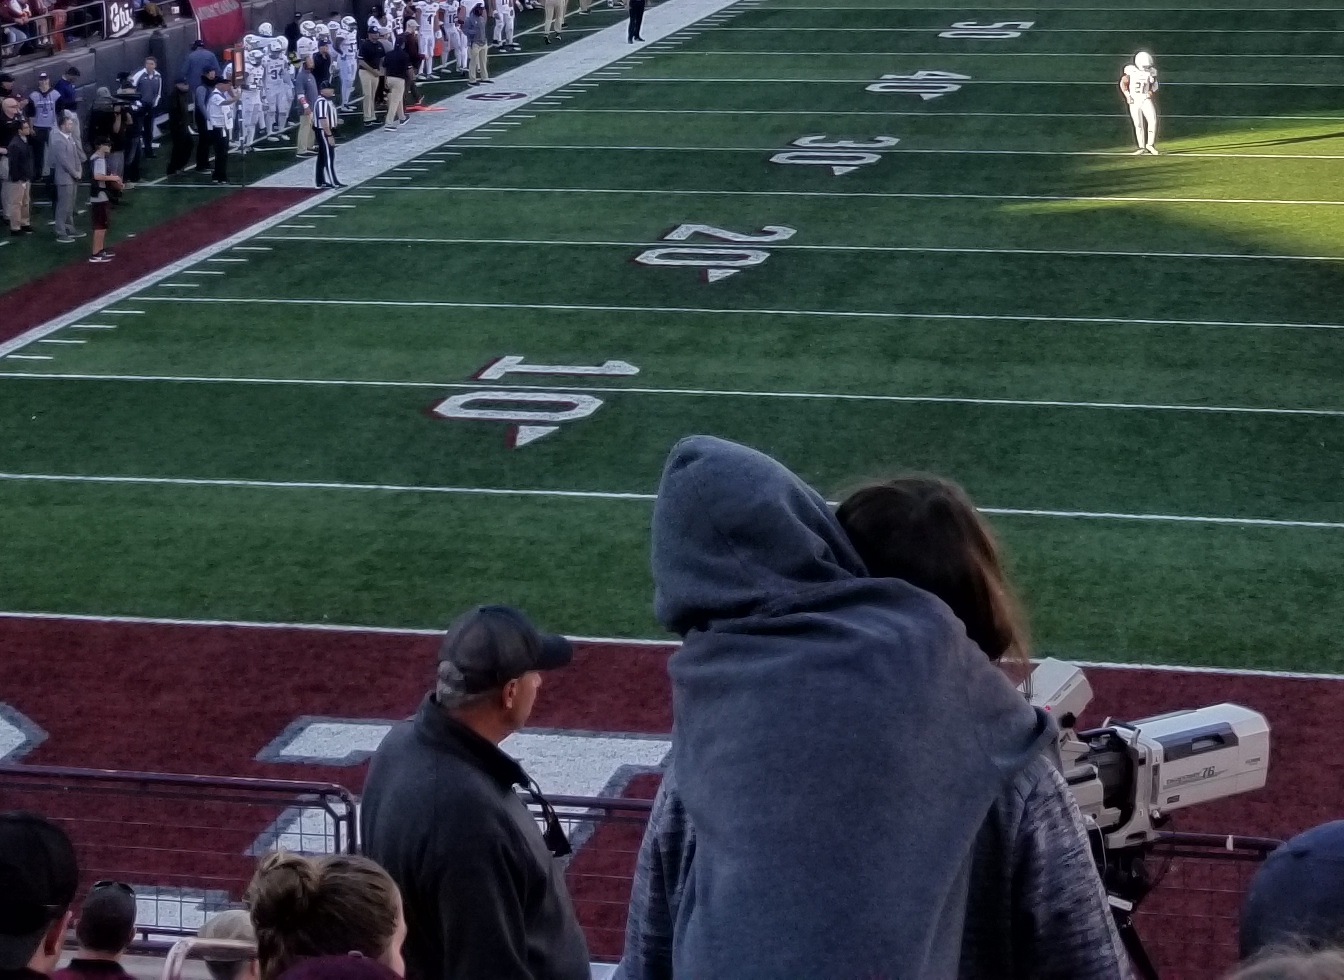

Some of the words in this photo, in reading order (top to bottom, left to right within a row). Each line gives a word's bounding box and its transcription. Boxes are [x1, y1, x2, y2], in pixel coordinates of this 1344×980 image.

[937, 21, 1035, 39] 50
[865, 70, 972, 93] 40
[769, 135, 900, 165] 30
[634, 224, 797, 267] 20
[432, 355, 640, 422] 10
